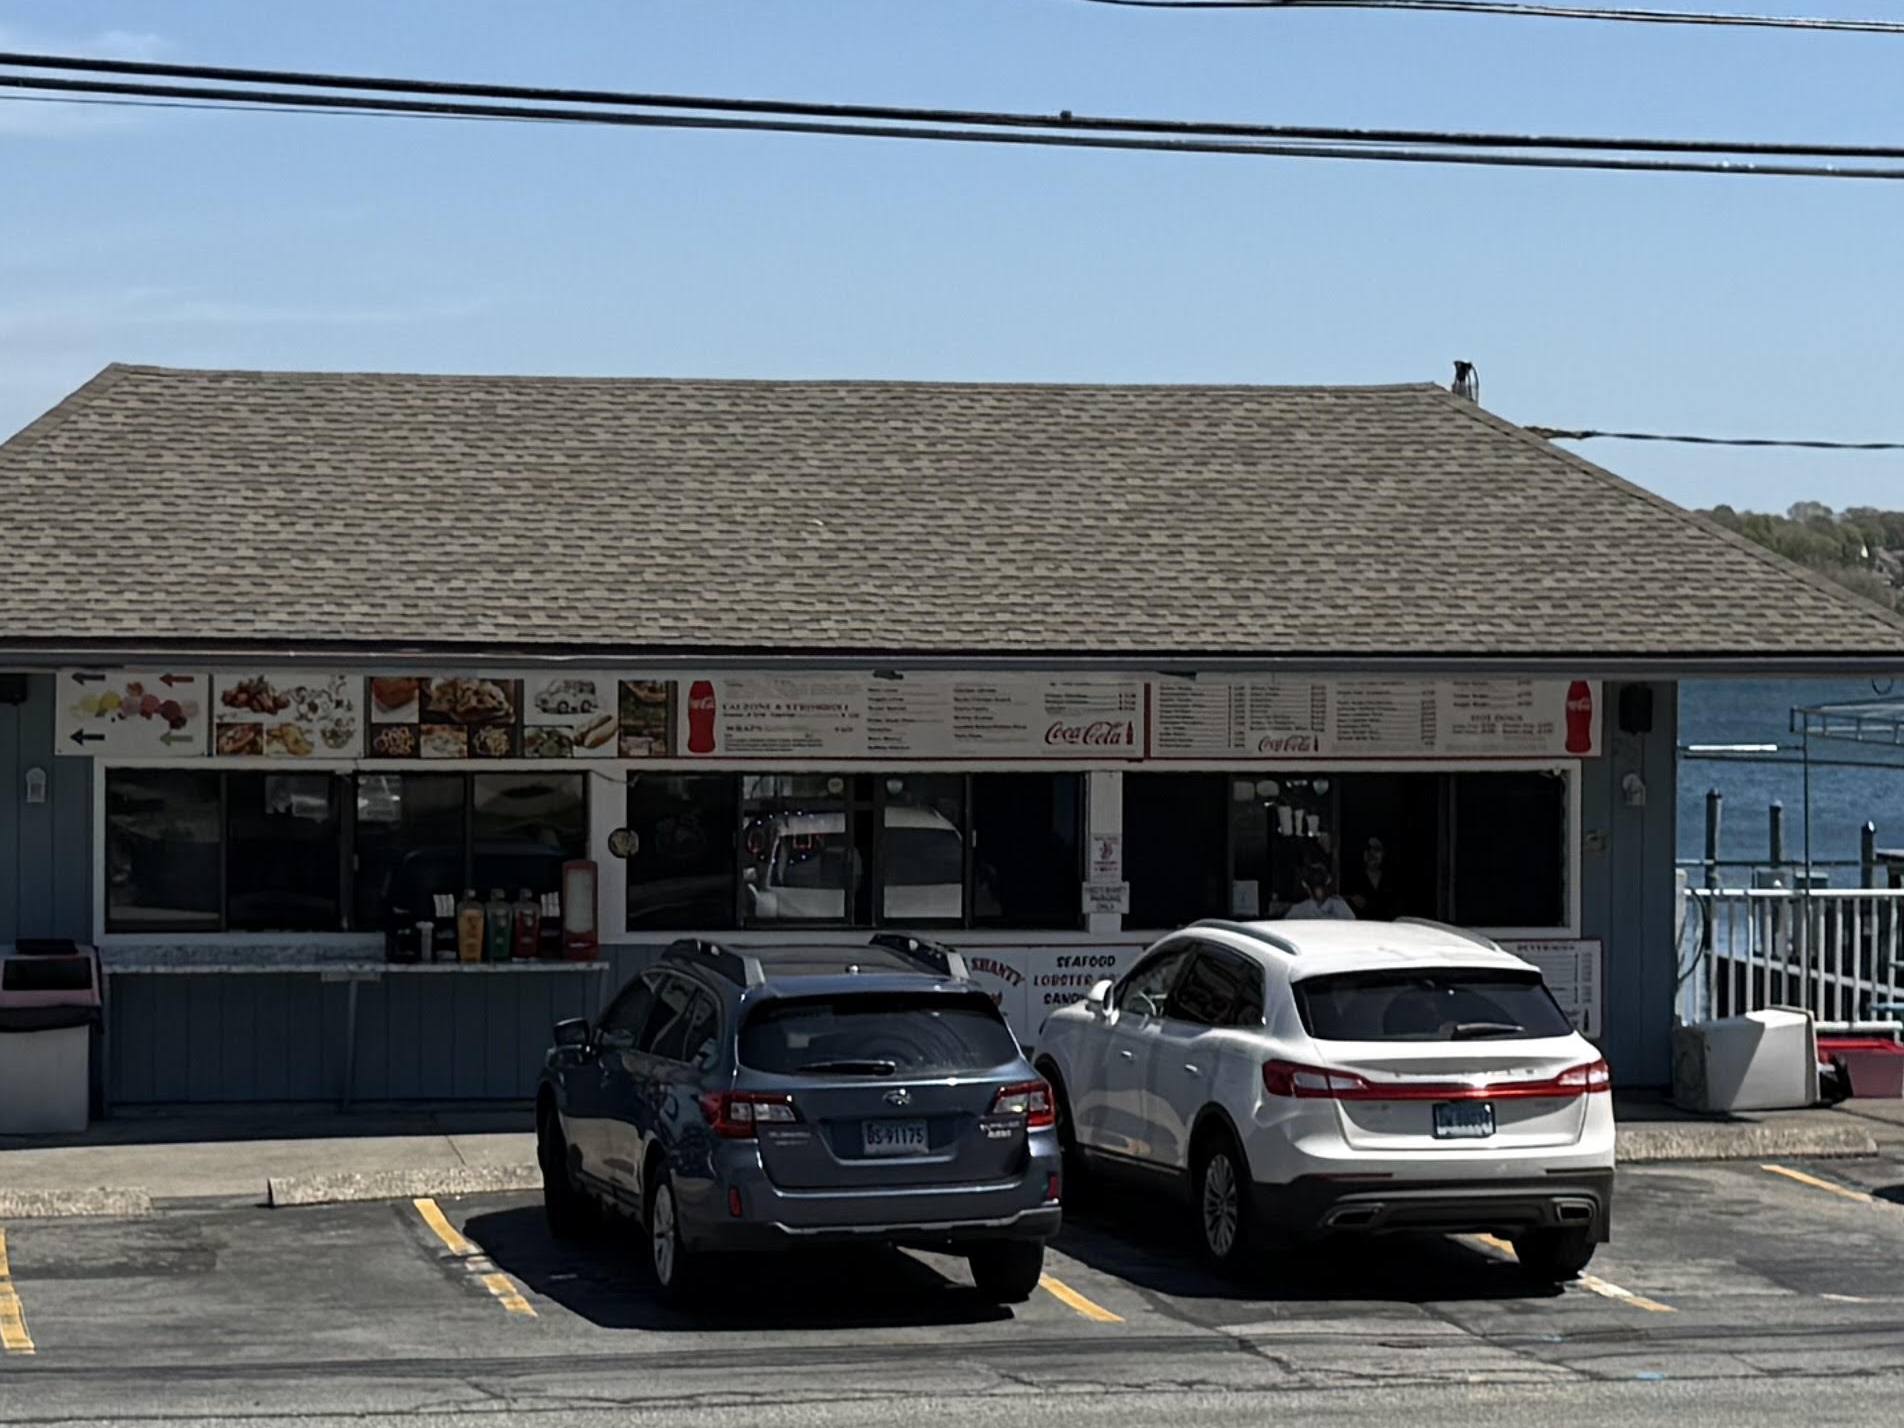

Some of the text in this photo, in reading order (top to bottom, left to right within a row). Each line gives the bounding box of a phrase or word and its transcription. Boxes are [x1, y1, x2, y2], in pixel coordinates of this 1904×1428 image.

[1056, 955, 1116, 968] SEAFOOD
[971, 957, 1026, 987] SHANTY
[1034, 974, 1090, 987] LOBSTER
